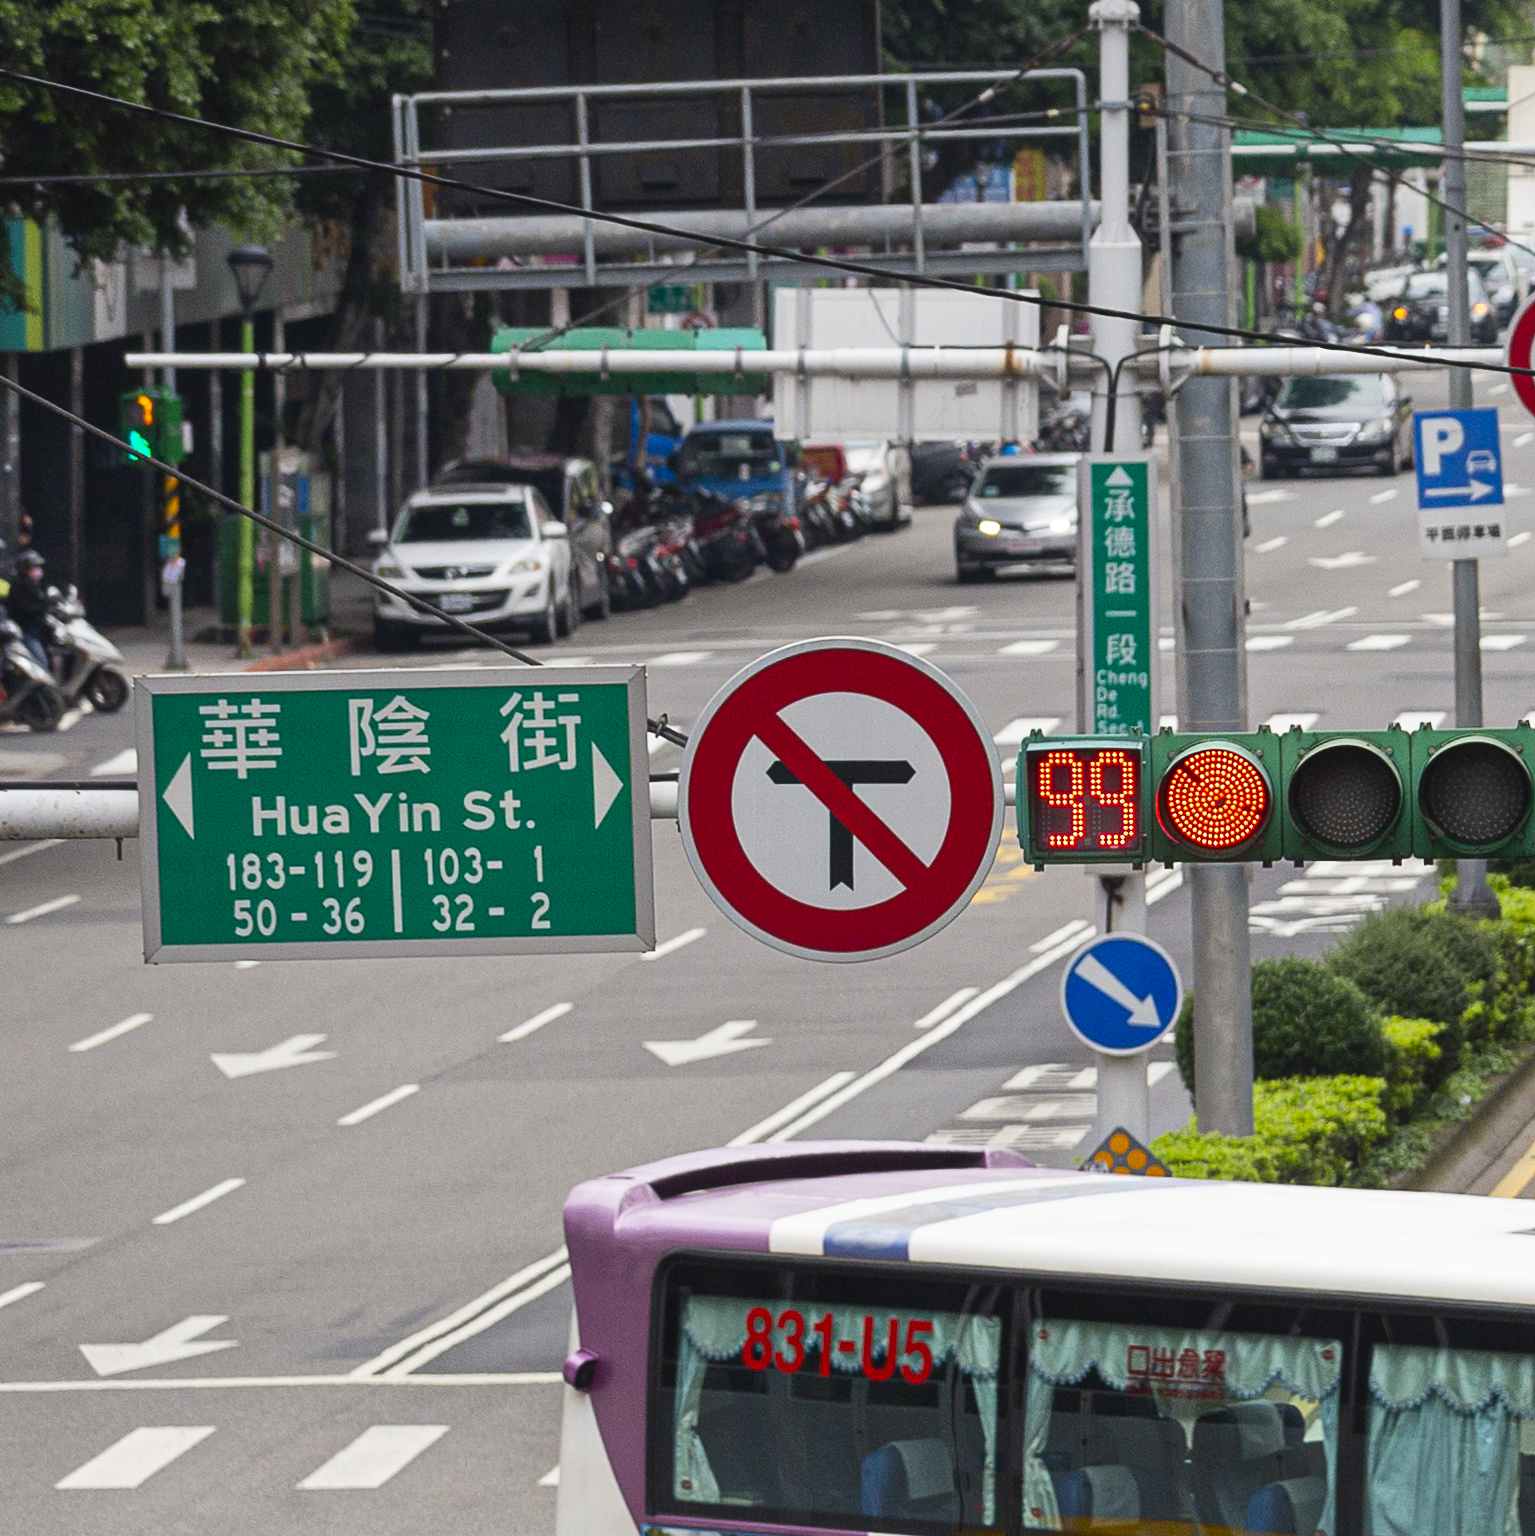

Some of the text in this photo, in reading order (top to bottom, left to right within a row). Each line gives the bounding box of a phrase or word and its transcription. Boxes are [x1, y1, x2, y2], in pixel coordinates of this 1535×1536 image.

[1421, 417, 1464, 476] P
[1103, 489, 1137, 667] 承德路一段
[1097, 668, 1148, 690] Cheng
[1097, 686, 1118, 703] De
[199, 691, 583, 780] 華陰街
[252, 788, 538, 838] HuaYin St.
[1038, 749, 1136, 850] 99
[225, 850, 375, 892] 183-119
[742, 1306, 935, 1385] 831-U5
